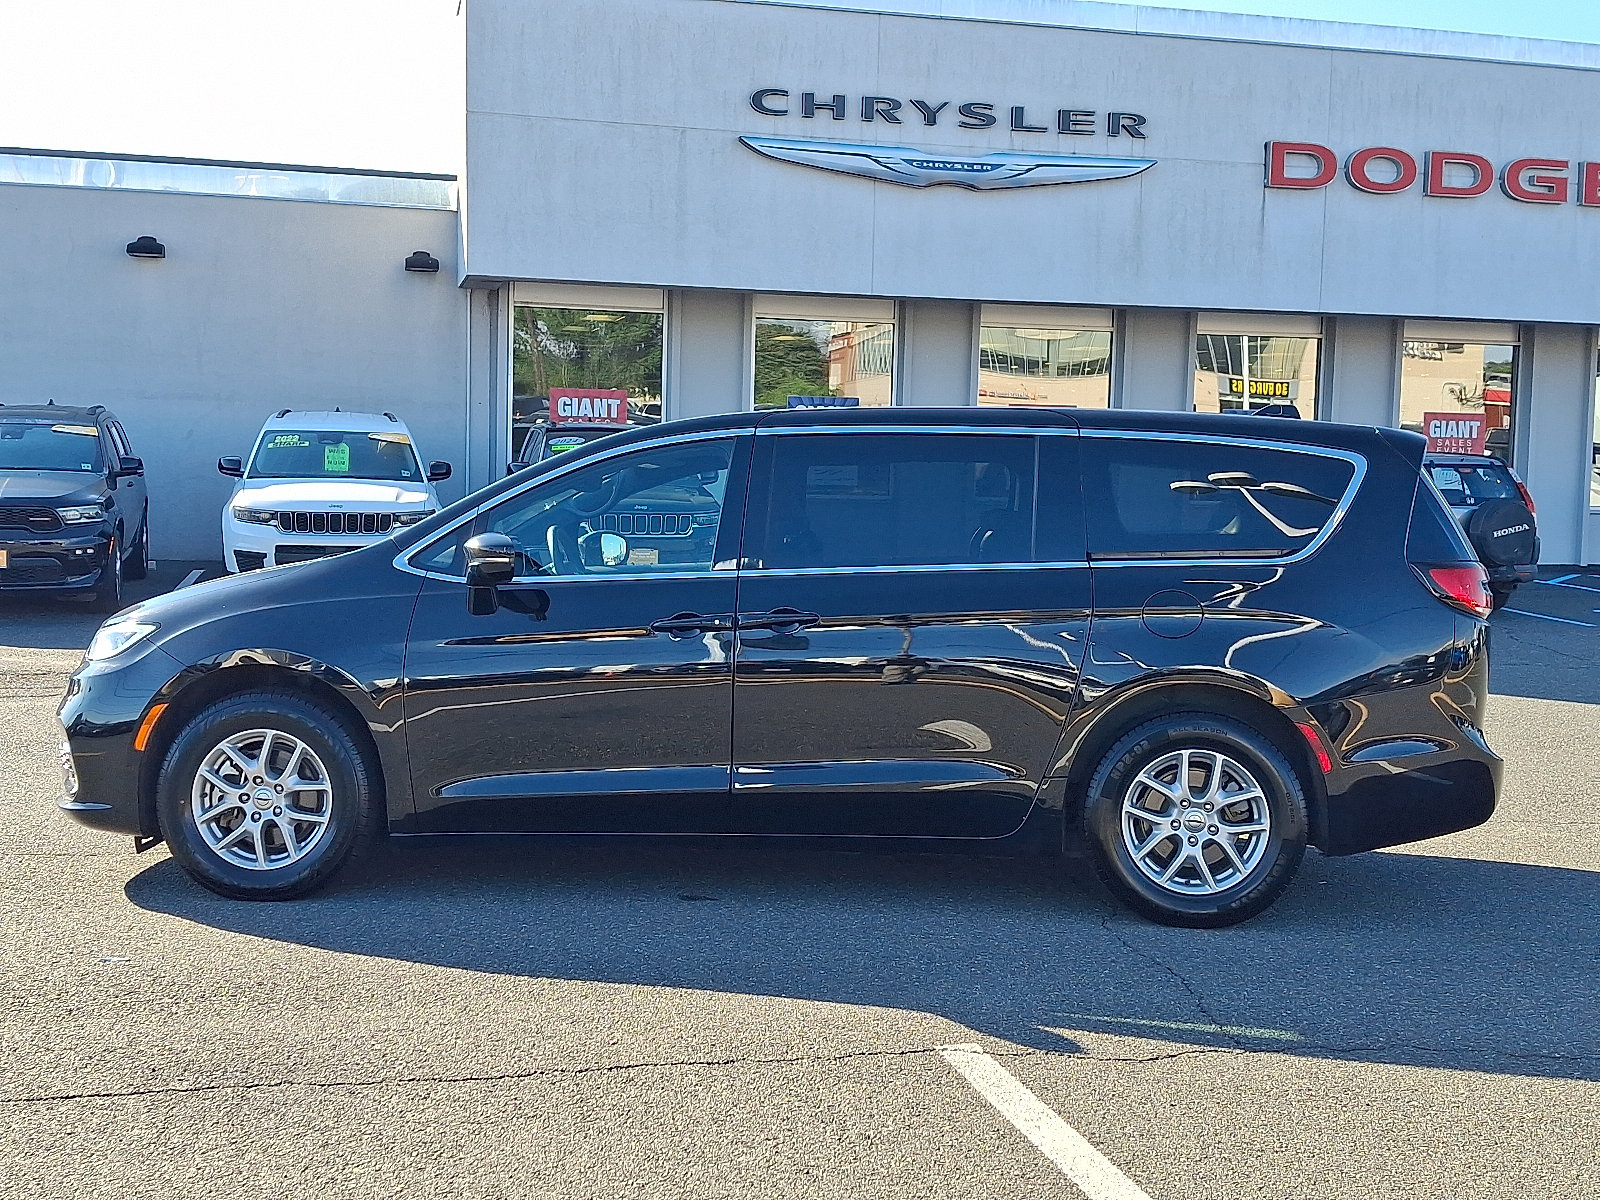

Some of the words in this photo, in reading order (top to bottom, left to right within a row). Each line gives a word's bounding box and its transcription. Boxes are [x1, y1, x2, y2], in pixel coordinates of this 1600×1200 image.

[750, 88, 1148, 138] CHRYSLER
[912, 161, 992, 171] CHRYSLER
[557, 396, 621, 419] GIANT
[1429, 419, 1481, 439] GIANT
[1436, 439, 1472, 447] SALES
[1493, 523, 1530, 538] HONDA
